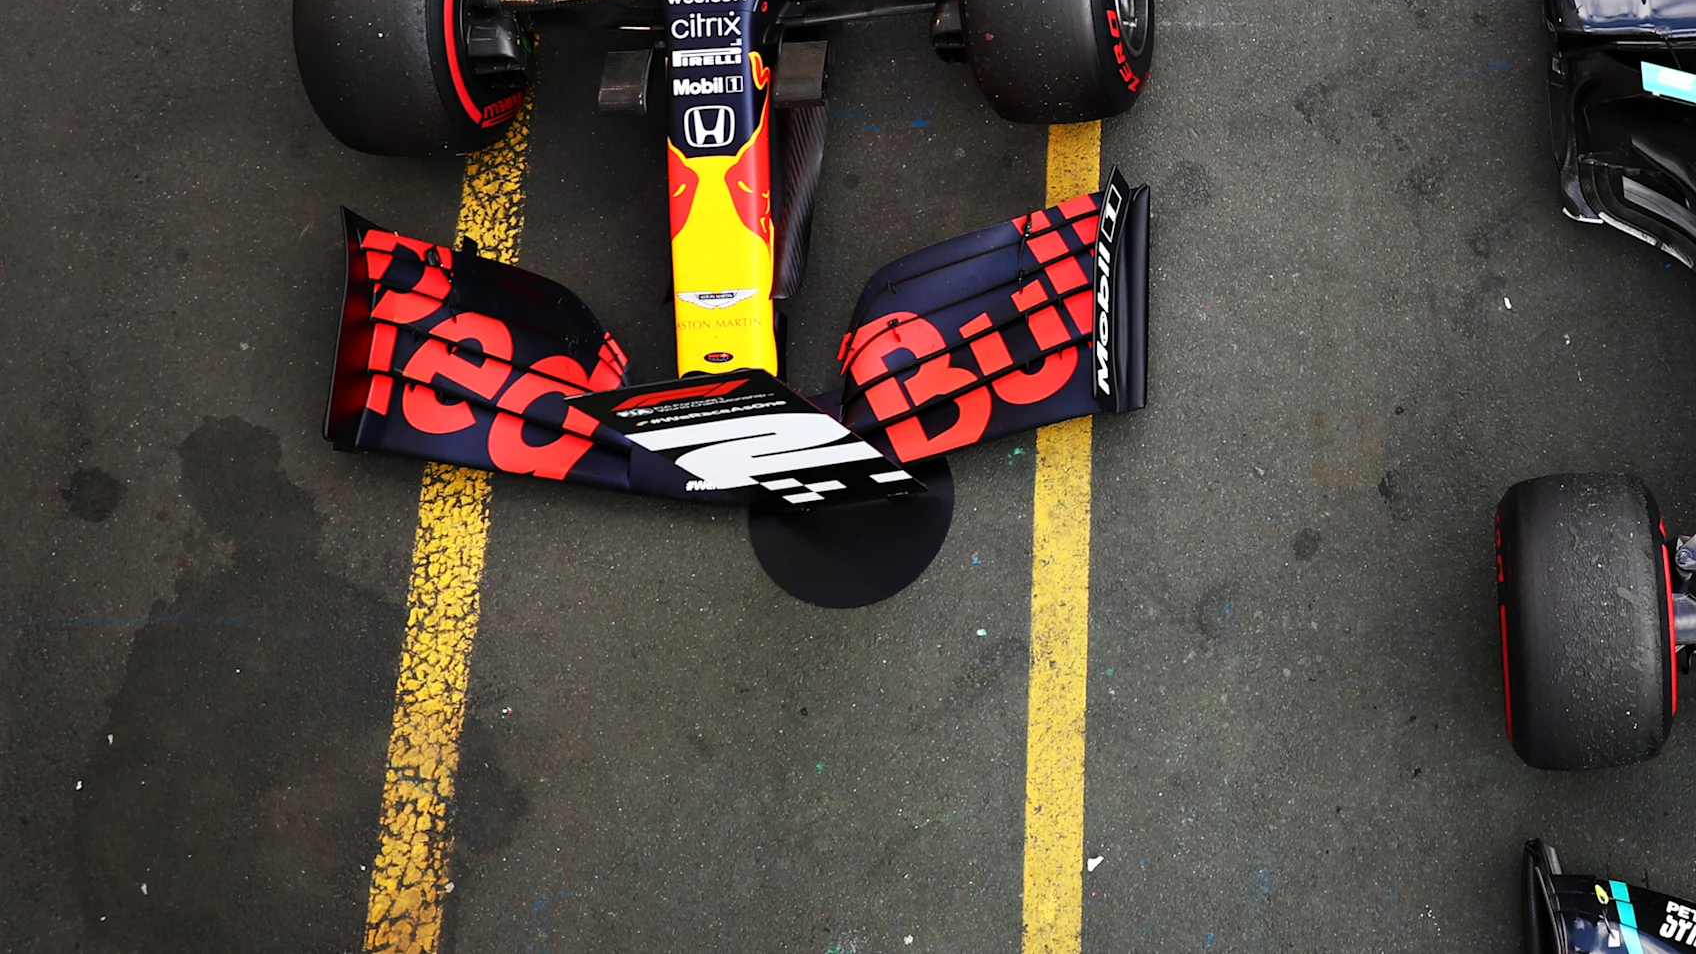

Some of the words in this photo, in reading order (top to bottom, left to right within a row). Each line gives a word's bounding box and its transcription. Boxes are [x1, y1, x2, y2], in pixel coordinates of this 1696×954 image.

[671, 10, 742, 39] citrix
[672, 47, 742, 67] PIRELLI
[673, 76, 724, 96] Mobil
[1097, 242, 1111, 396] Mobil
